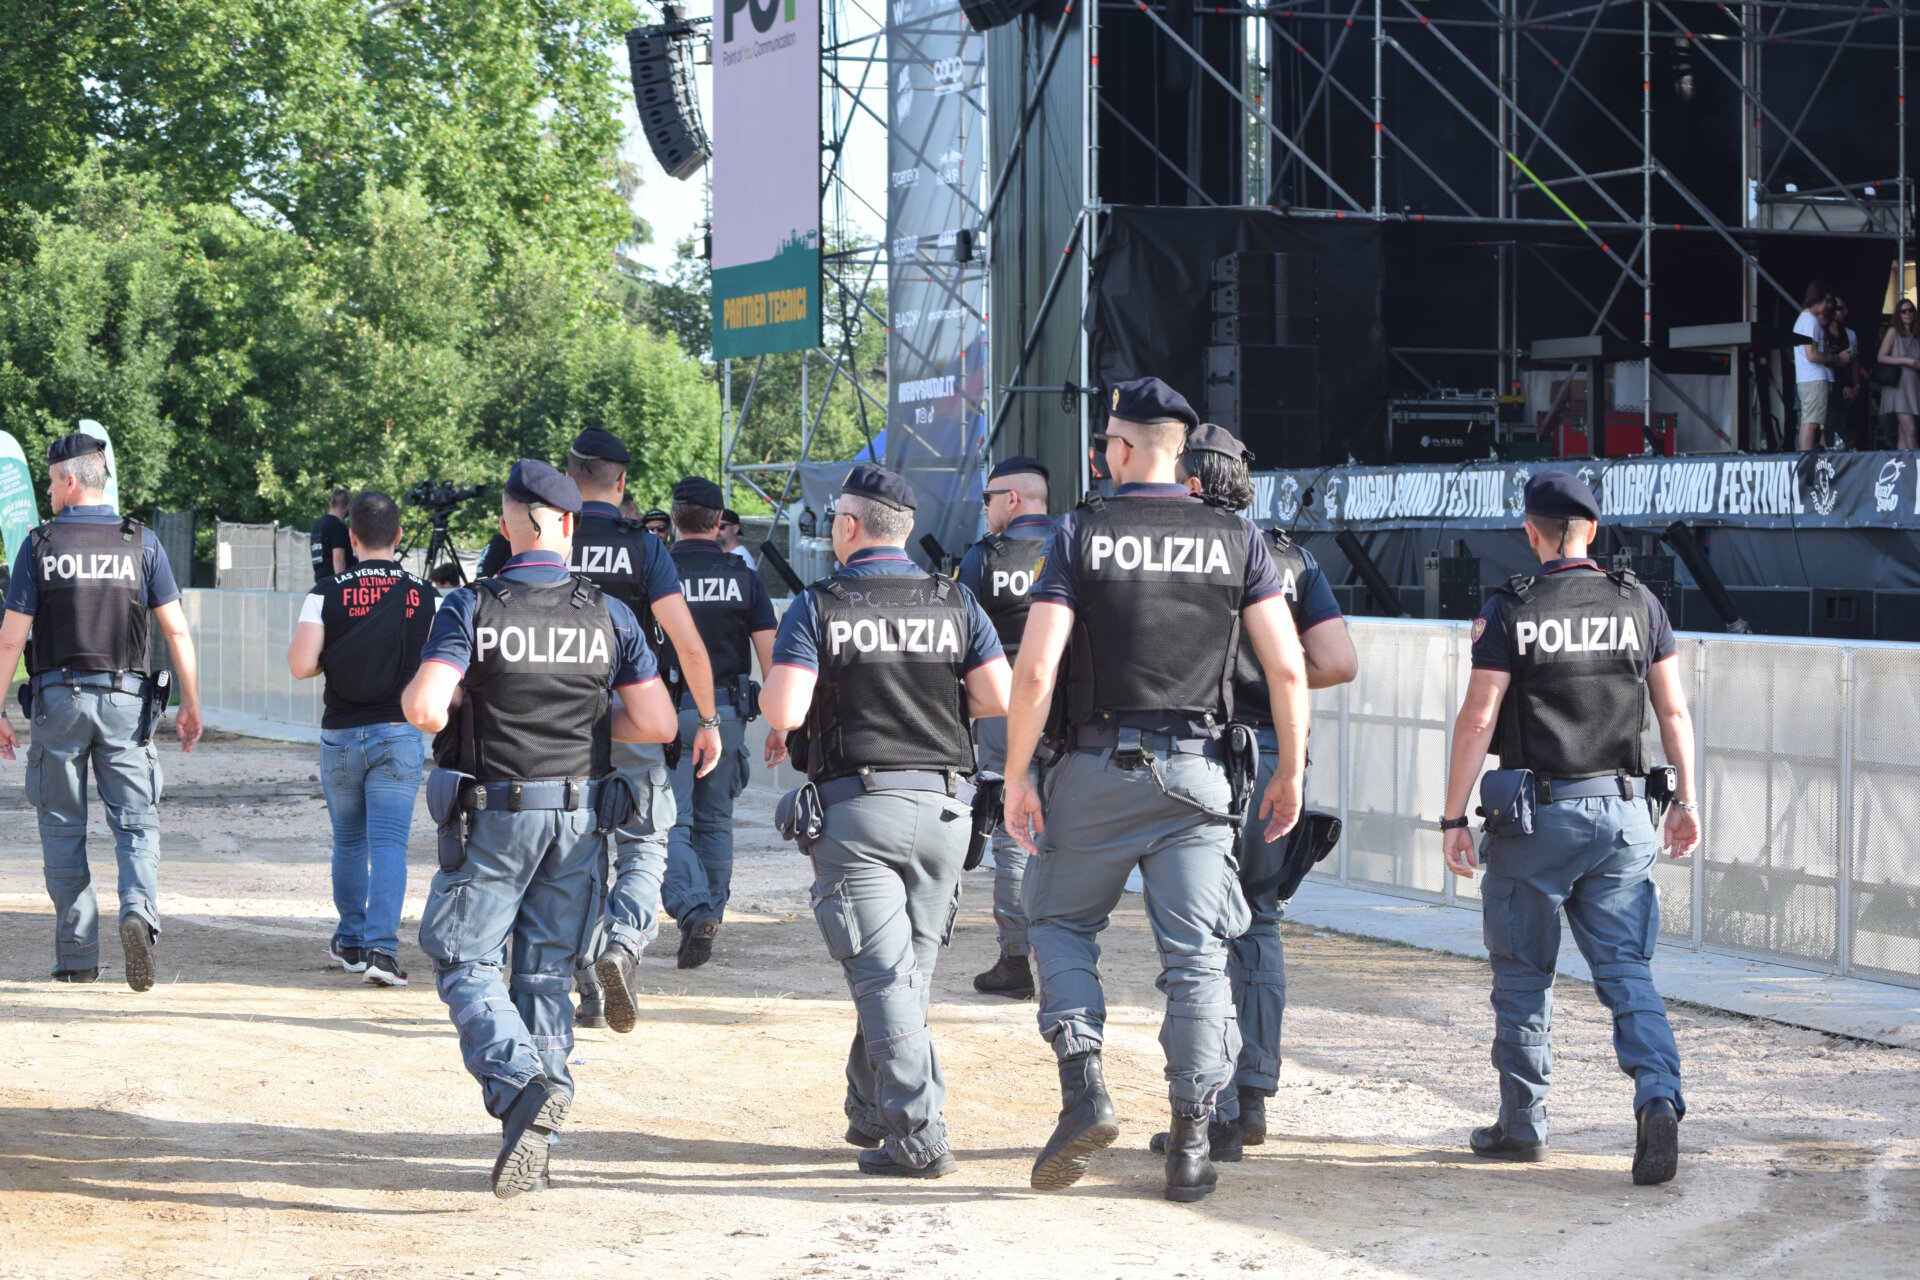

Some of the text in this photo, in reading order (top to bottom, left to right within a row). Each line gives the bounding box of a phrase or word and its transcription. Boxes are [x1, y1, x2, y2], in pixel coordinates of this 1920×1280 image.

[754, 32, 797, 58] Communication
[723, 286, 807, 331] PARTNER TECNICI
[1344, 474, 1394, 520] RUGBY
[1436, 470, 1506, 518] FESTIVAL
[1602, 460, 1805, 516] RUGBY SOUND FESTIVAL
[42, 554, 136, 581] POLIZIA
[566, 546, 633, 575] LIZIA
[1091, 535, 1231, 575] POLIZIA
[335, 572, 353, 584] LAS
[355, 567, 388, 577] VEGAS,
[359, 577, 400, 587] ULTIMAT
[680, 577, 743, 602] LIZIA
[476, 625, 609, 664] POLIZIA
[830, 618, 959, 656] POLIZIA
[1516, 616, 1640, 656] POLIZIA
